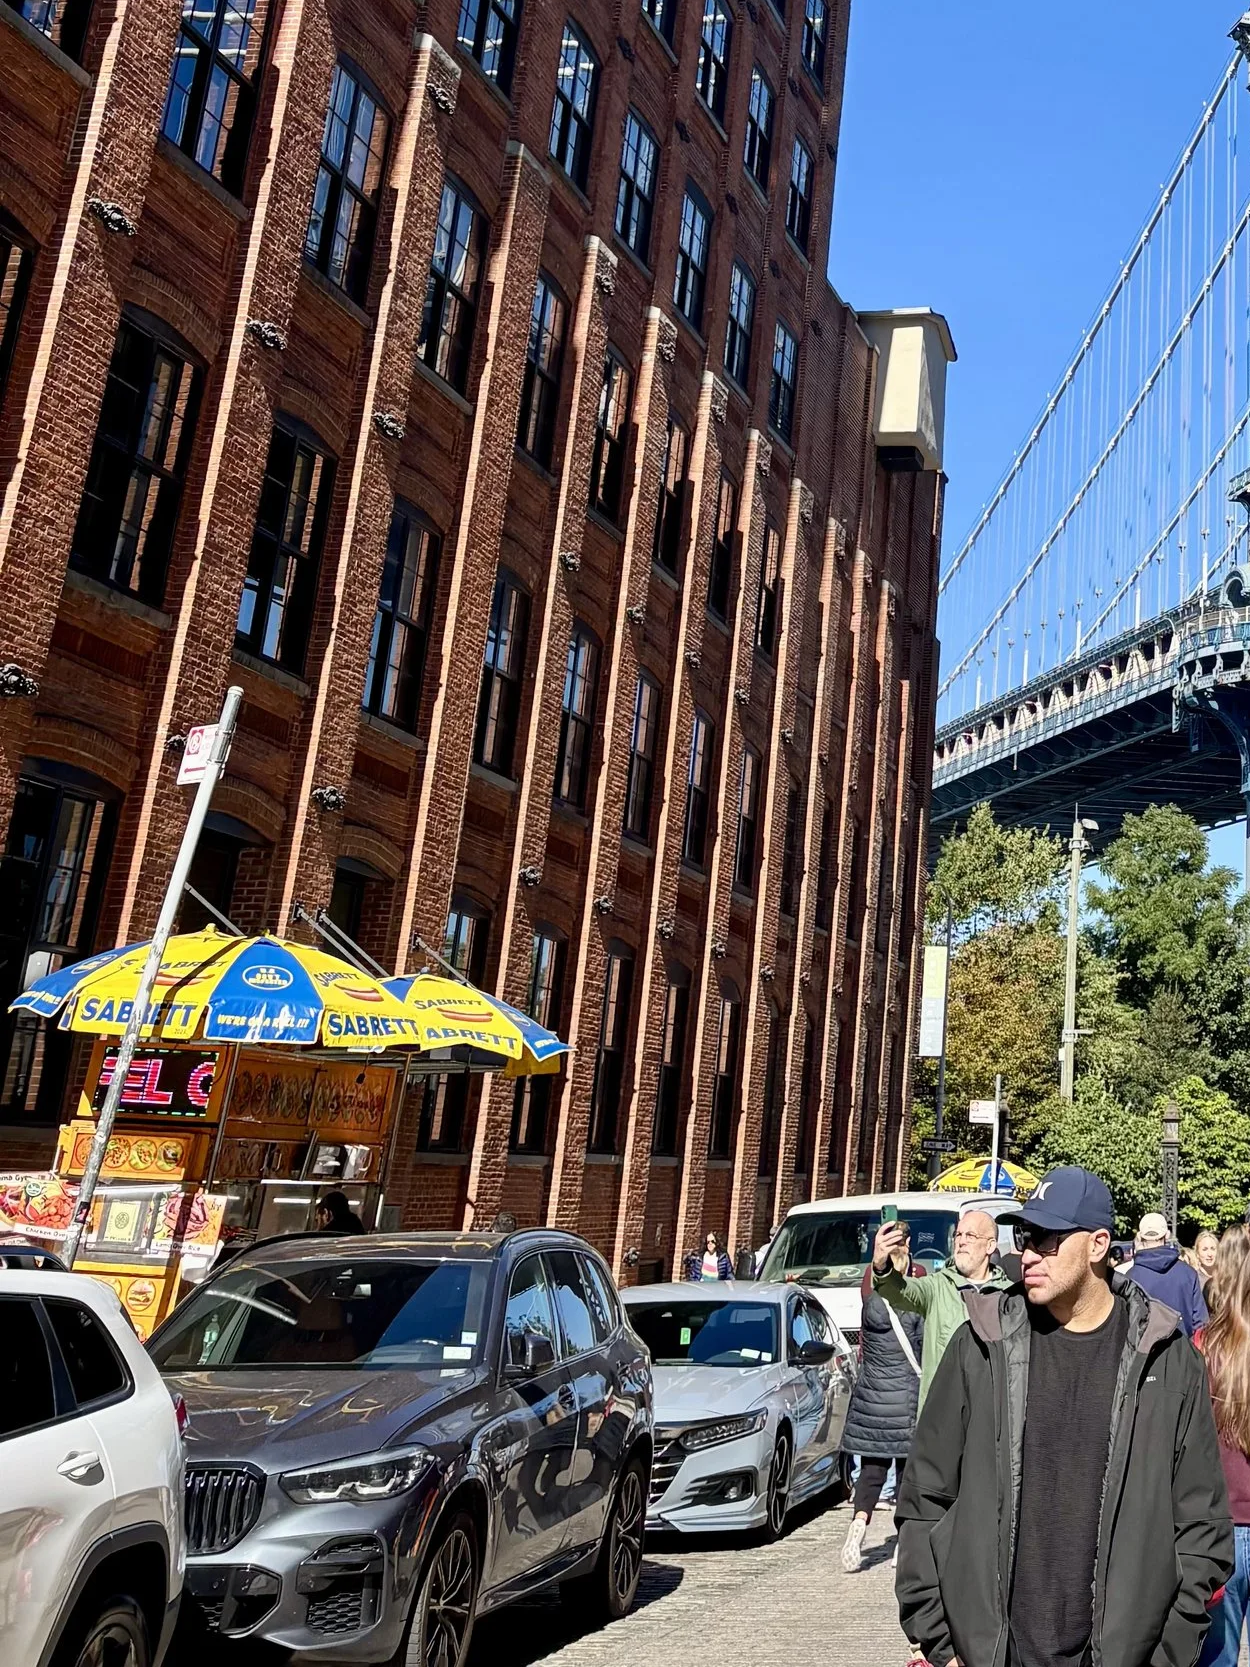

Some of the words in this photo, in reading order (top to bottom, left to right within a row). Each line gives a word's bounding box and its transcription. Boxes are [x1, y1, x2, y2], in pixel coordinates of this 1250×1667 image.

[314, 971, 361, 987] SABRETT
[414, 998, 482, 1010] SABRETT
[328, 1013, 420, 1037] SABRETT
[426, 1027, 518, 1050] ABRETT
